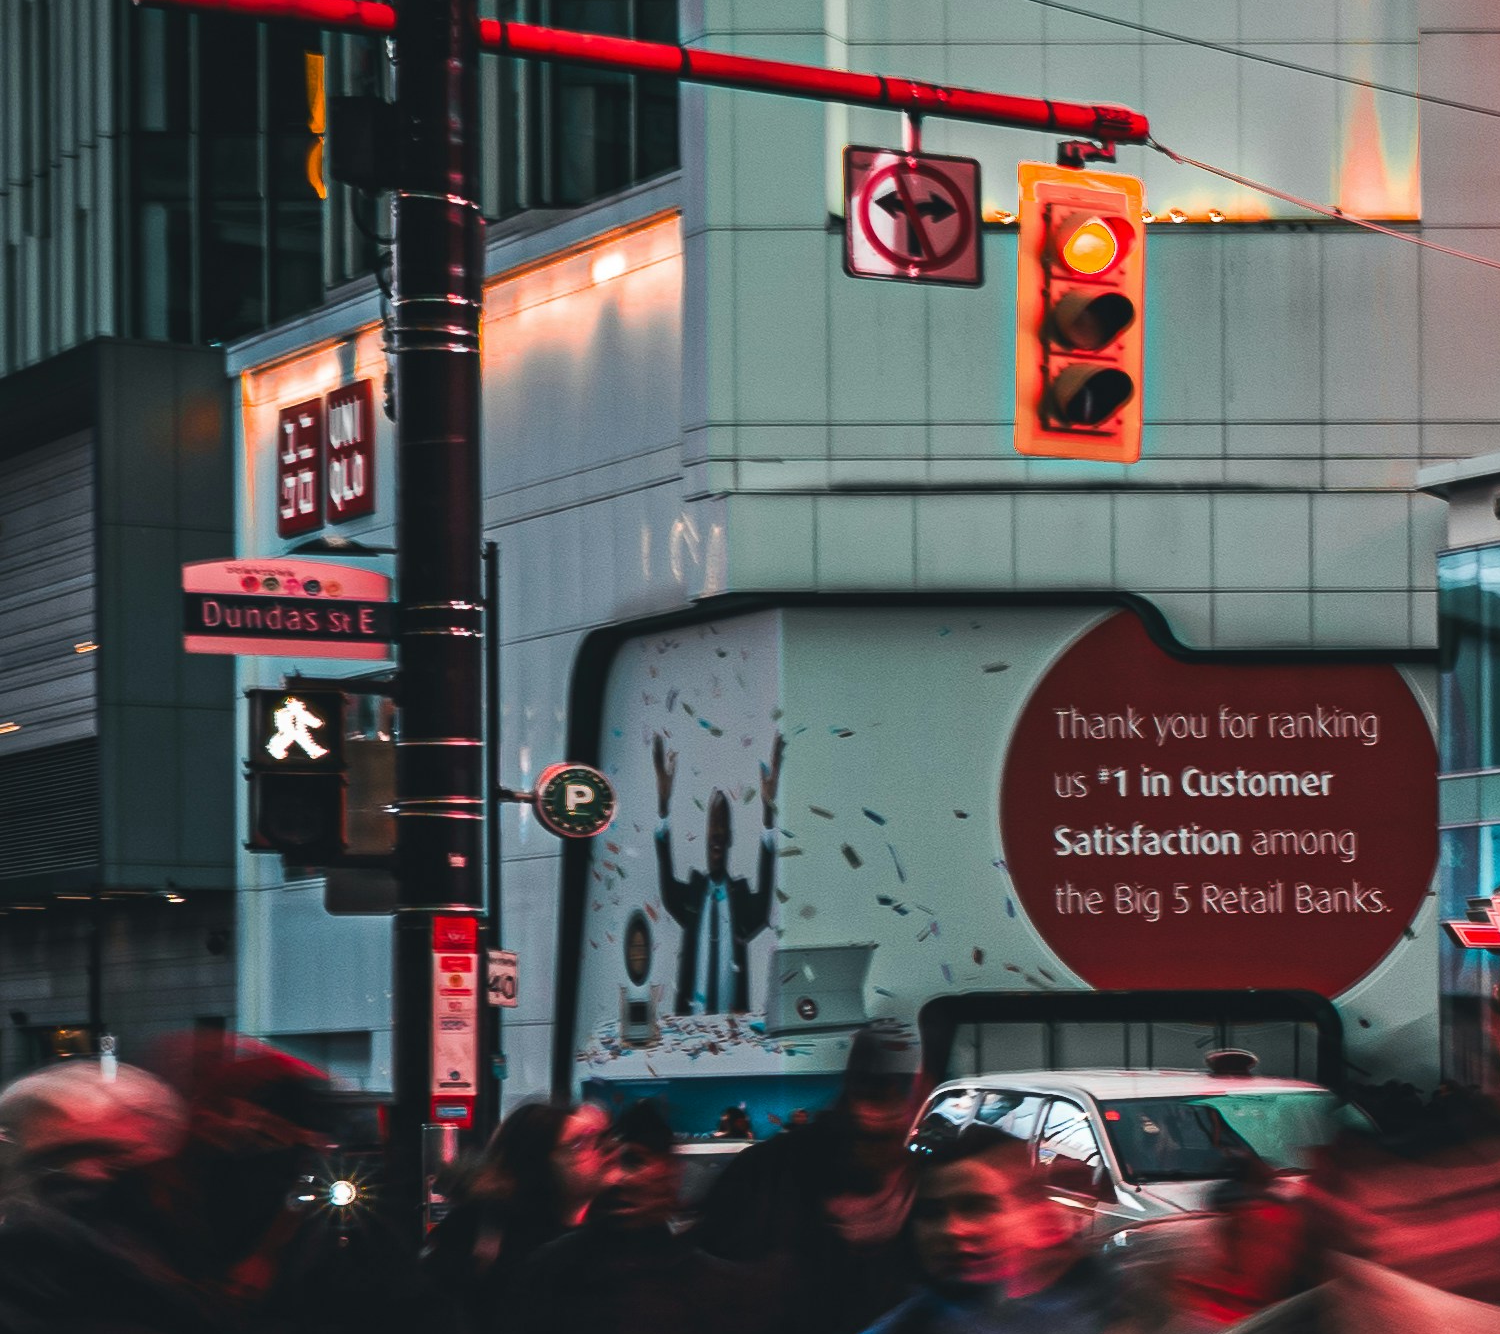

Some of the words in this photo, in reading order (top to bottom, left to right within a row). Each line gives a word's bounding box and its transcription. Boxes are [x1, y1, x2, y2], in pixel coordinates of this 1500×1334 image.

[202, 600, 320, 632] Dundas
[327, 609, 352, 633] St
[358, 608, 377, 635] E
[1053, 704, 1144, 740] Thank
[1152, 713, 1208, 746] you
[1217, 704, 1259, 740] for
[1267, 704, 1381, 746] ranking
[565, 784, 595, 811] P
[1053, 771, 1089, 798] us
[1097, 767, 1129, 797] #1
[1141, 764, 1172, 797] in
[1181, 767, 1334, 798] Customer
[1053, 822, 1242, 857] Satisfaction
[1250, 828, 1359, 863] among
[1054, 880, 1104, 915] the
[1113, 880, 1163, 922] Big
[1171, 882, 1194, 914] 5
[1201, 879, 1286, 914] Retail
[1294, 880, 1394, 914] Banks.
